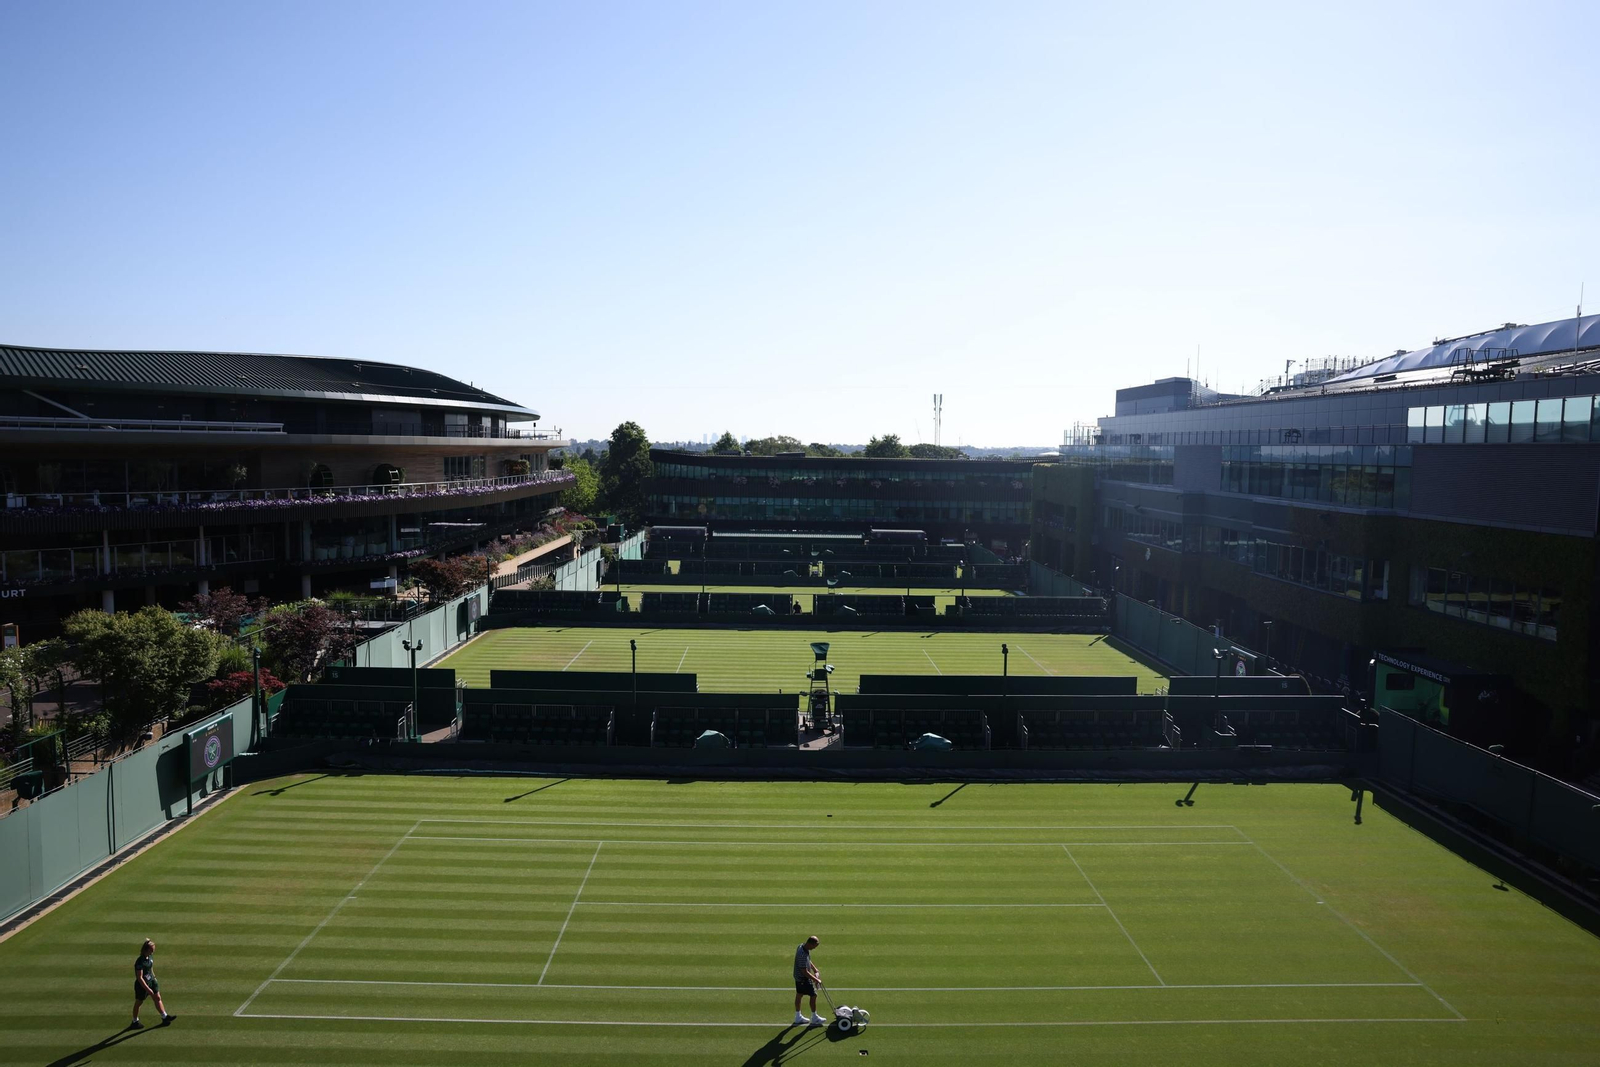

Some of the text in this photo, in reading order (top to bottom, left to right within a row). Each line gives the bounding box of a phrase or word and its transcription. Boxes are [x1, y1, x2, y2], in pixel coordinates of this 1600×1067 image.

[1, 589, 26, 598] URT
[1379, 653, 1411, 670] TECHNOLOGY
[1411, 666, 1443, 682] EXPERIENCE
